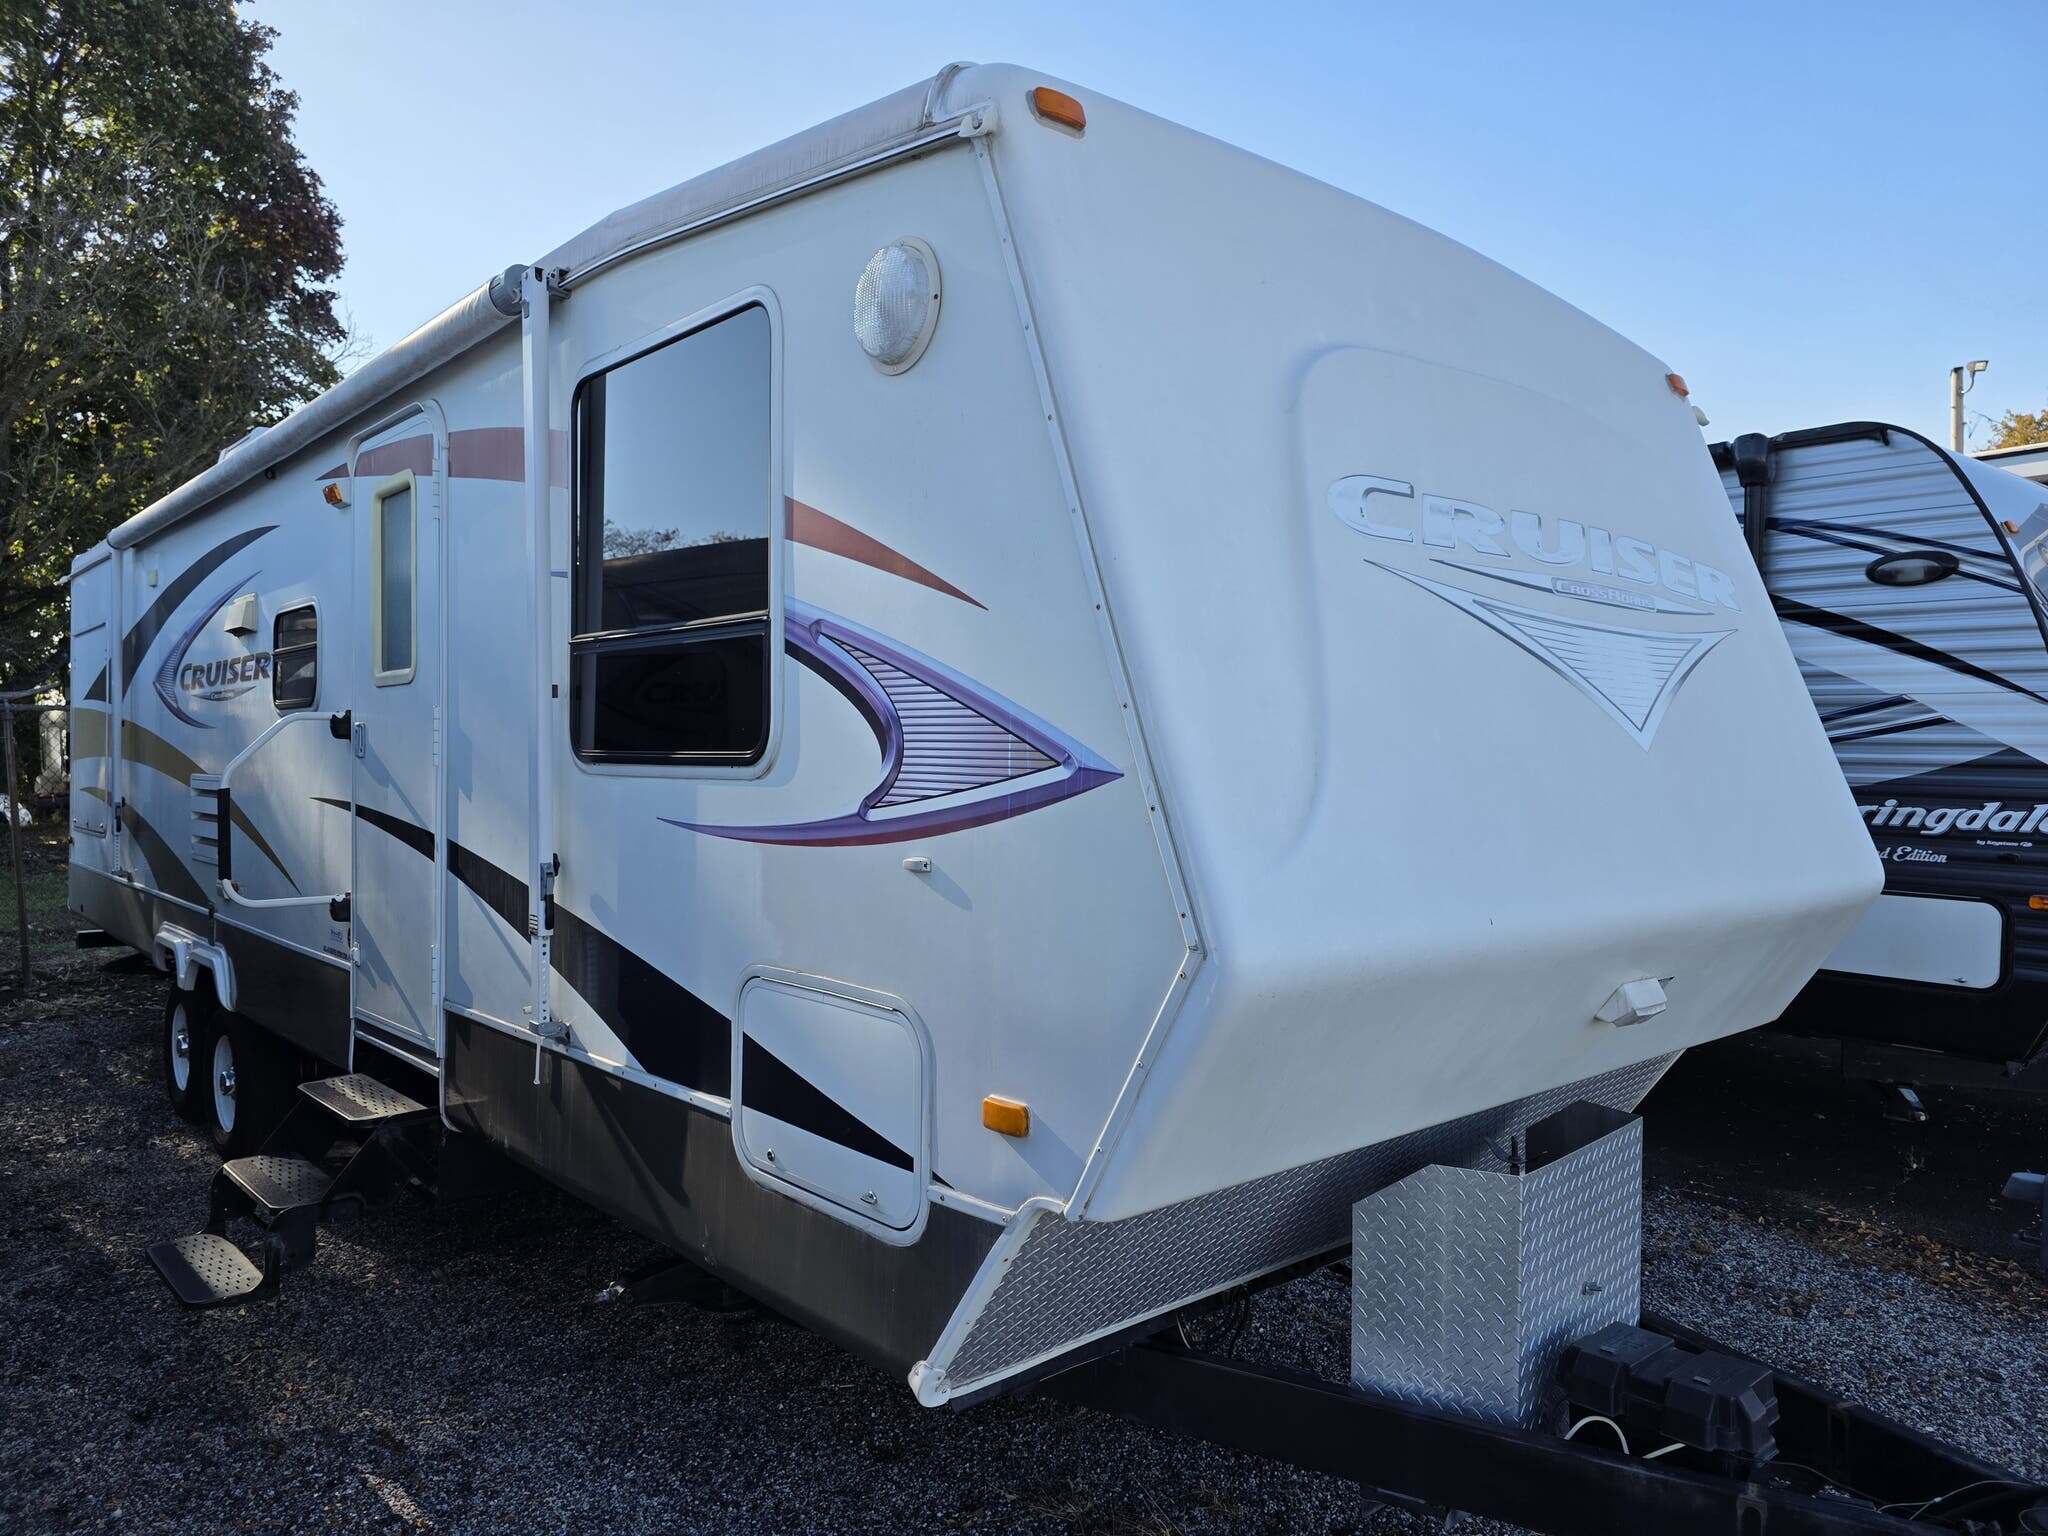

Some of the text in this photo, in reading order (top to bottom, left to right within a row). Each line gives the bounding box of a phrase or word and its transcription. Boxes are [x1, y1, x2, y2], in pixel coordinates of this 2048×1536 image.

[1326, 473, 1744, 614] CRUISER
[180, 651, 272, 691] CRUISER
[1892, 846, 1948, 864] Edition
